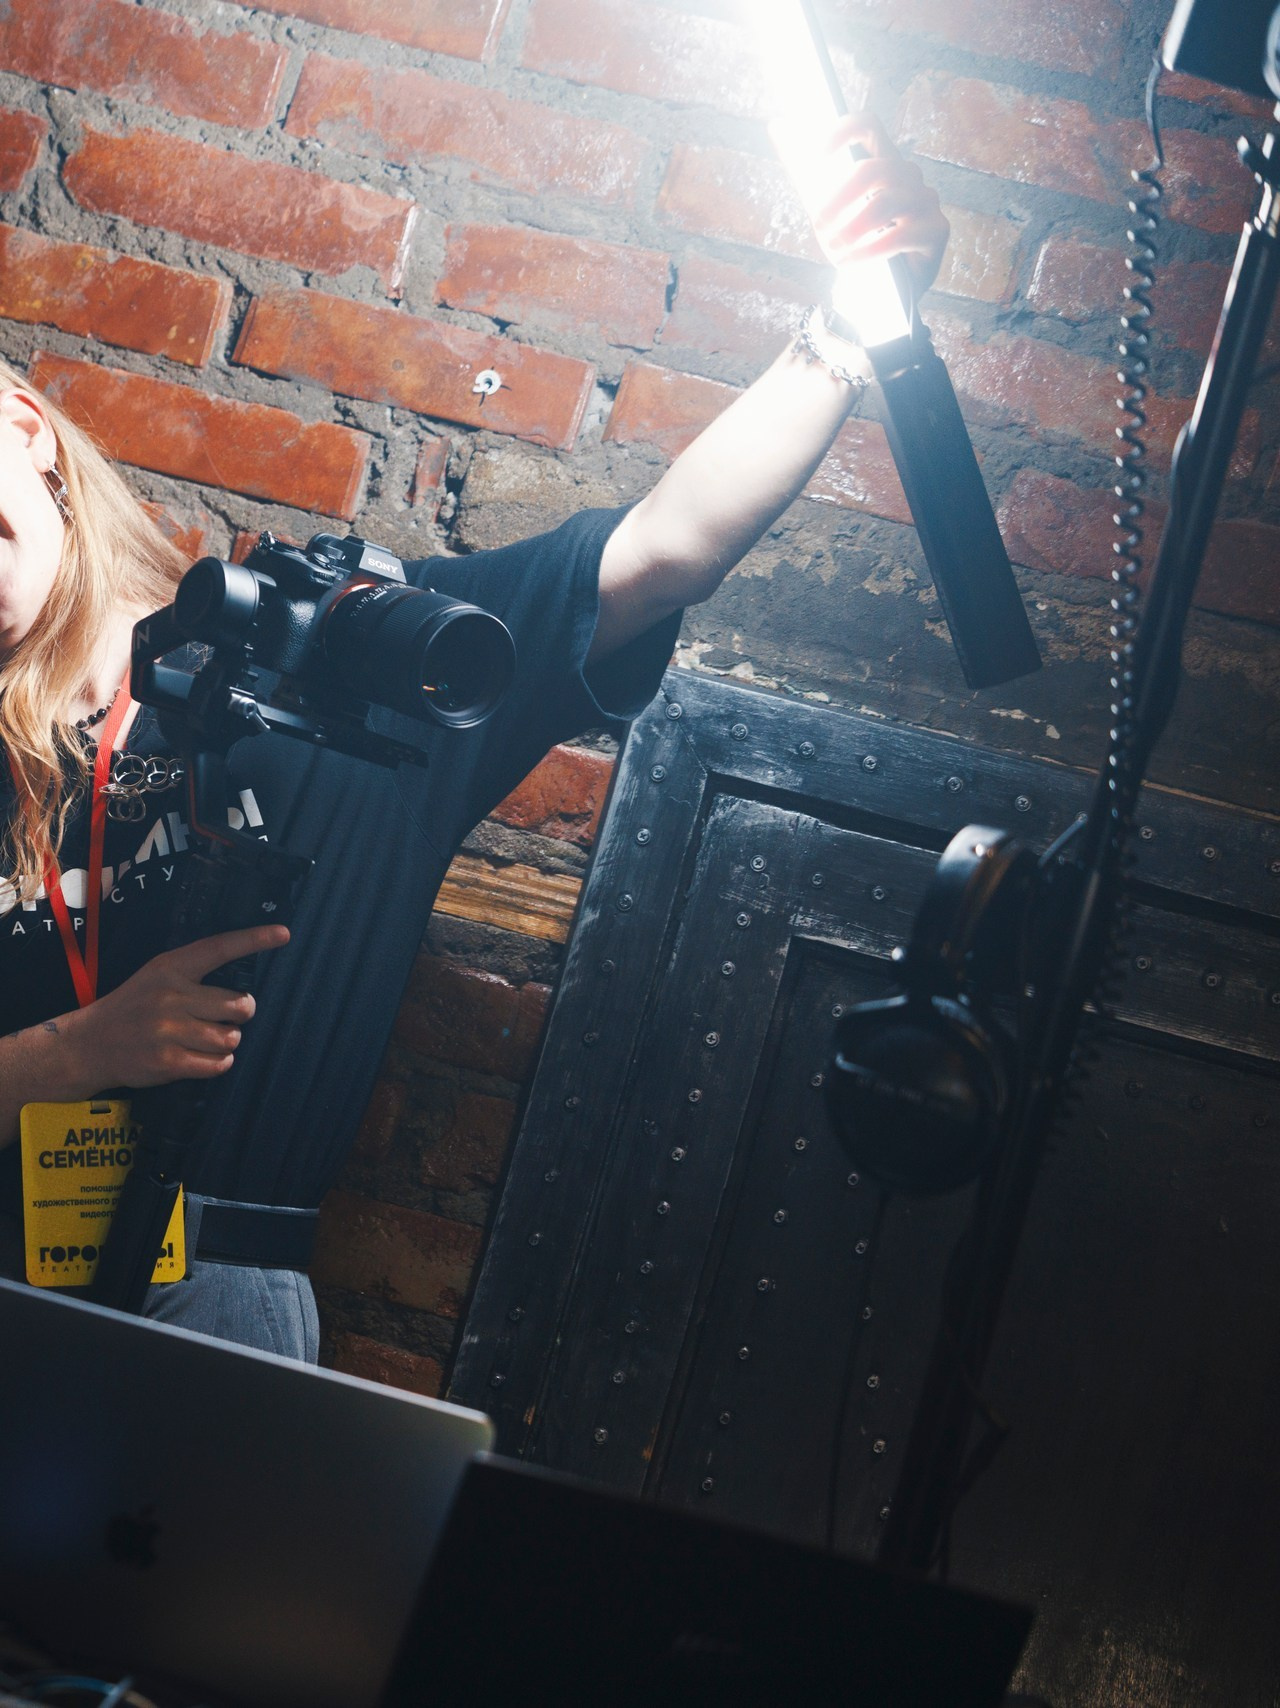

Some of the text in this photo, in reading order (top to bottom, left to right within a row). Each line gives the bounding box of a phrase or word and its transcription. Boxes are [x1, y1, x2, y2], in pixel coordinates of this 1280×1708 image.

[367, 557, 399, 574] SONY
[64, 1127, 138, 1147] АРИНА
[39, 1147, 132, 1169] СЕМЁНО
[80, 1184, 123, 1193] помощни
[32, 1198, 110, 1209] художественного
[41, 1265, 92, 1273] ТЕАТР
